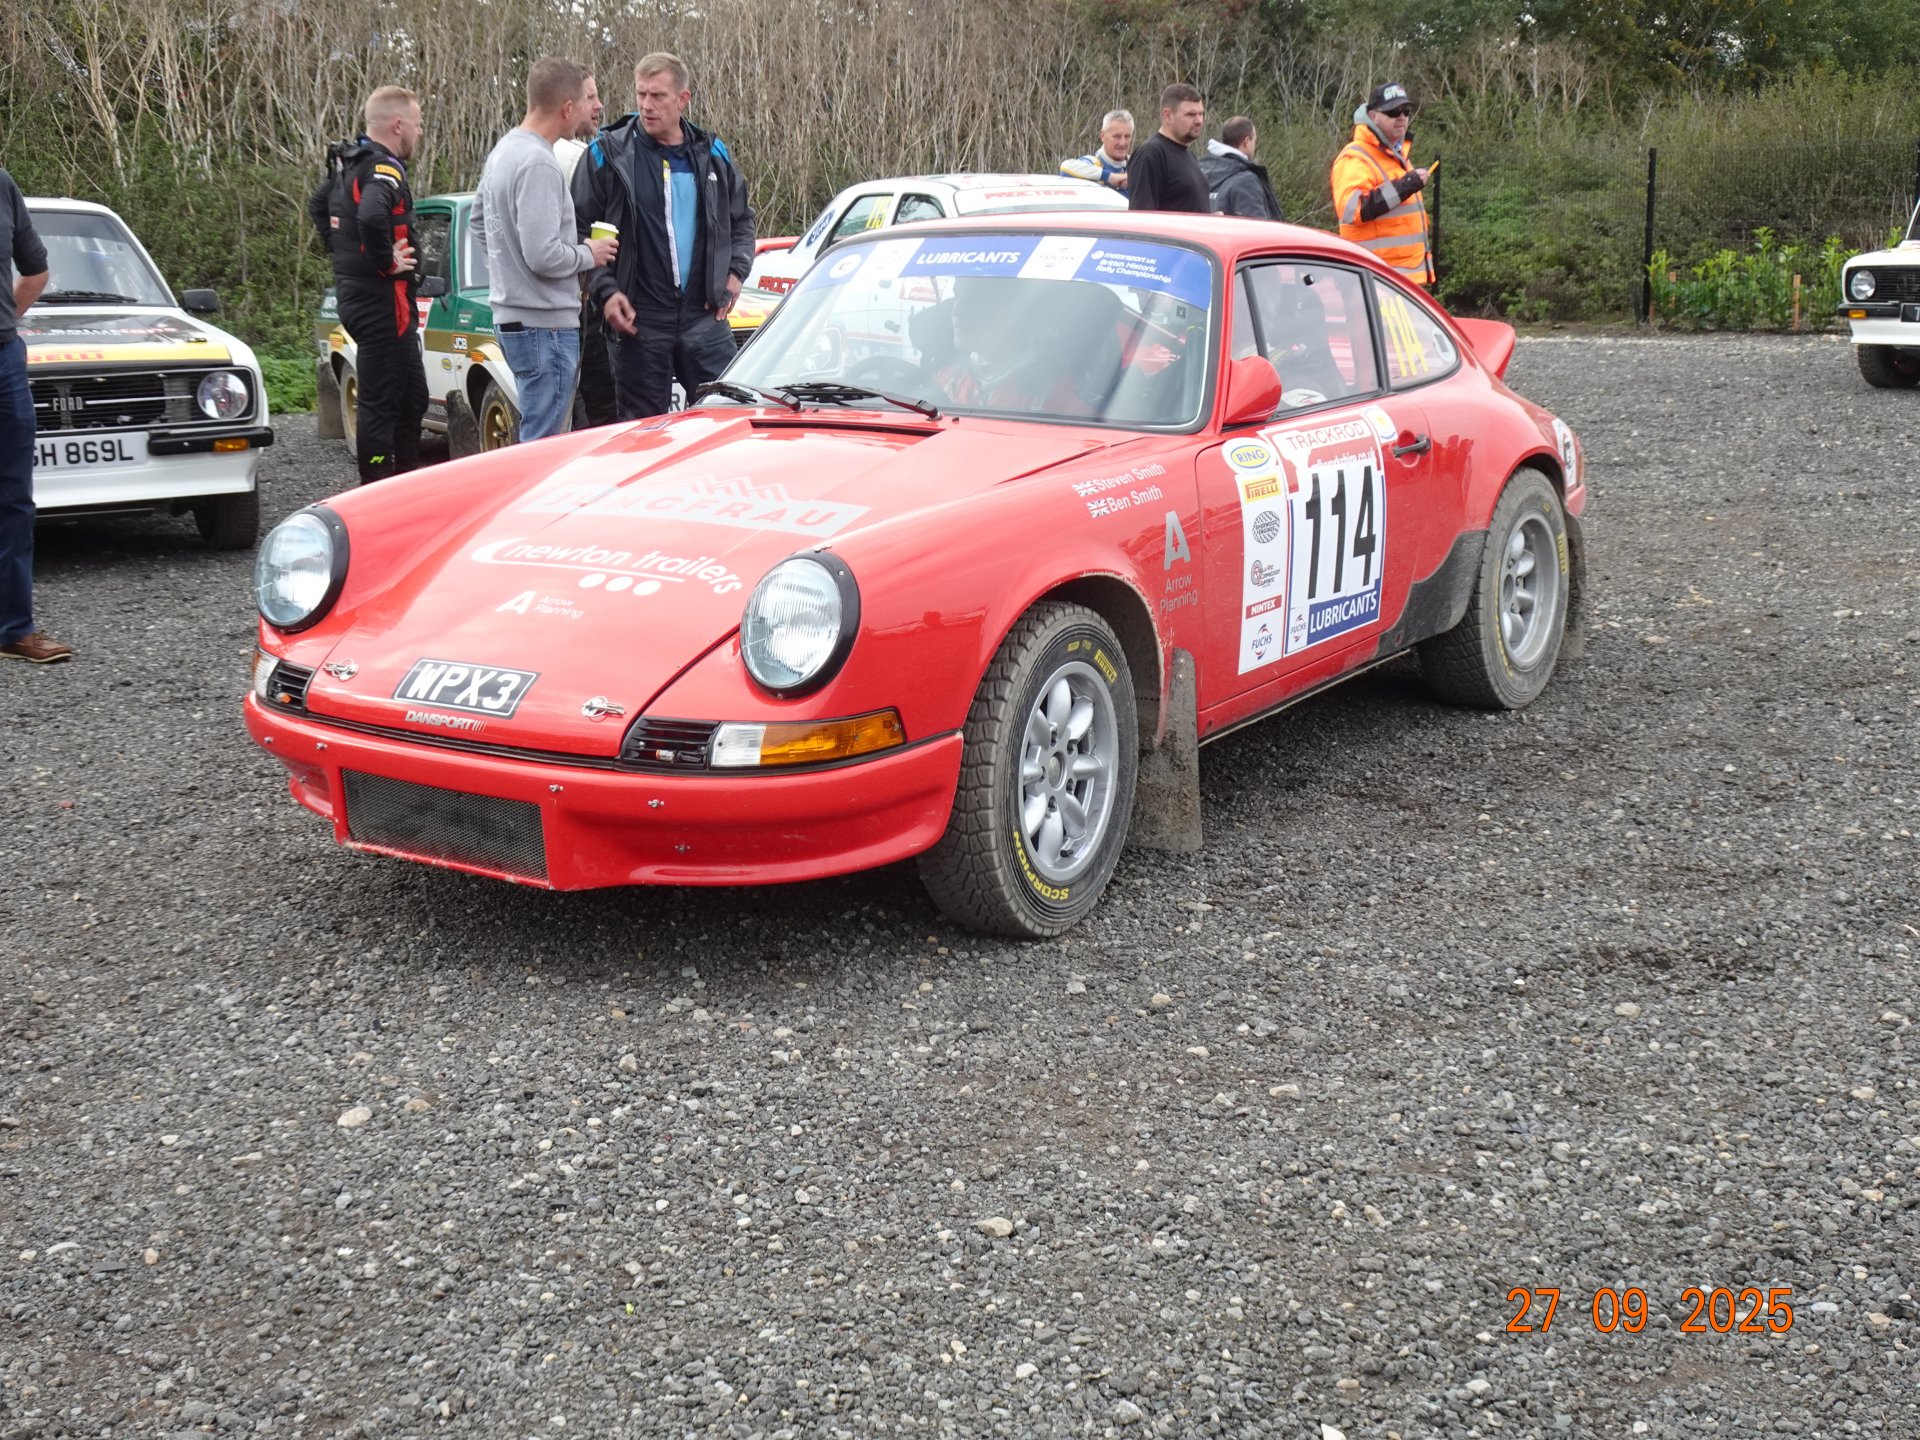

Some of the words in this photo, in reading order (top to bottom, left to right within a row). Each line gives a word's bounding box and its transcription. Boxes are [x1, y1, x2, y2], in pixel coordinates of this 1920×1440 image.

[811, 215, 832, 241] Ford
[917, 251, 1020, 265] LUBRICANTS
[1099, 259, 1125, 268] British
[1125, 261, 1157, 273] Historic
[1103, 252, 1146, 263] motorsport
[1095, 264, 1115, 274] Rally
[1115, 267, 1172, 284] Championship
[453, 337, 467, 350] JCB
[1381, 294, 1429, 378] 114
[53, 396, 83, 412] FORD
[1286, 422, 1364, 450] TRACKROD
[65, 439, 134, 464] 869L
[1236, 449, 1265, 463] RING
[1093, 473, 1134, 491] Steven
[1131, 463, 1166, 480] Smith
[1106, 495, 1132, 512] Ben
[1130, 485, 1163, 505] Smith
[1245, 477, 1278, 499] PIRELLI
[1306, 465, 1377, 600] 114
[504, 544, 632, 565] newton
[631, 550, 742, 594] trailers
[1165, 573, 1193, 594] Arrow
[532, 603, 584, 618] Planning
[538, 595, 576, 606] Arrow
[1159, 590, 1198, 614] Planning
[1251, 598, 1276, 616] MINTEX
[1309, 591, 1377, 634] LUBRICANTS
[1290, 623, 1307, 635] FUCHS
[1252, 634, 1273, 650] FUCHS
[1094, 649, 1117, 683] PIRELLI
[406, 662, 522, 710] WPX3
[405, 710, 475, 731] DANSPORT
[1013, 831, 1070, 900] SCORPION
